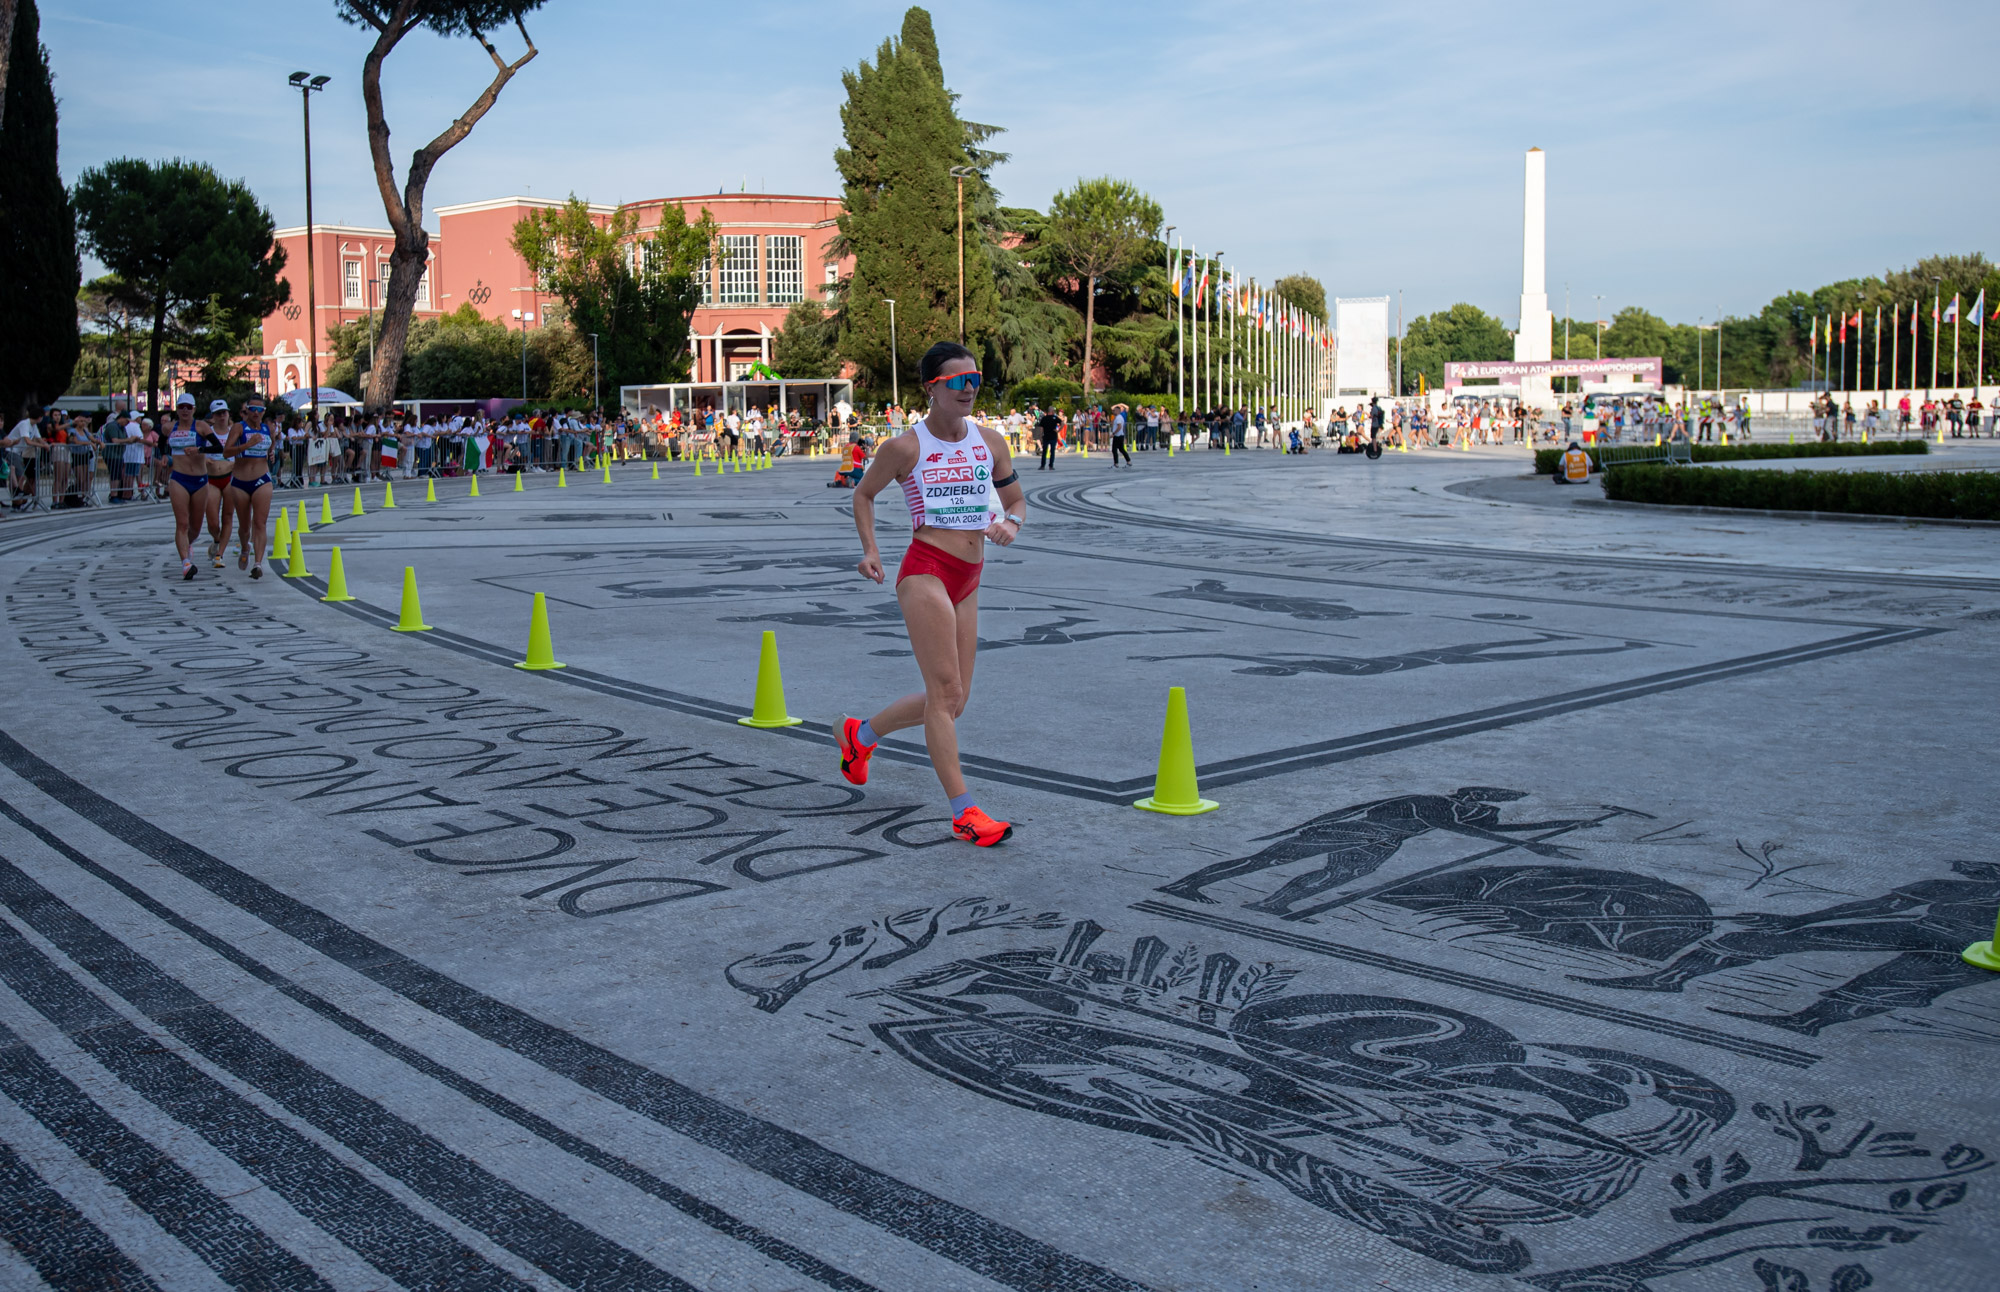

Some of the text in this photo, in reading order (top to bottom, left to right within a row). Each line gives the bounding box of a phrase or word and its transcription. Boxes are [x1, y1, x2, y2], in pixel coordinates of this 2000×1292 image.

[1480, 362, 1655, 375] EUROPEAN ATHLETICS CHAMPIONSHIPS
[924, 468, 972, 482] SPAR
[926, 484, 986, 497] ZDZIEBŁO
[950, 497, 965, 505] 126
[935, 514, 982, 525] ROMA 2024
